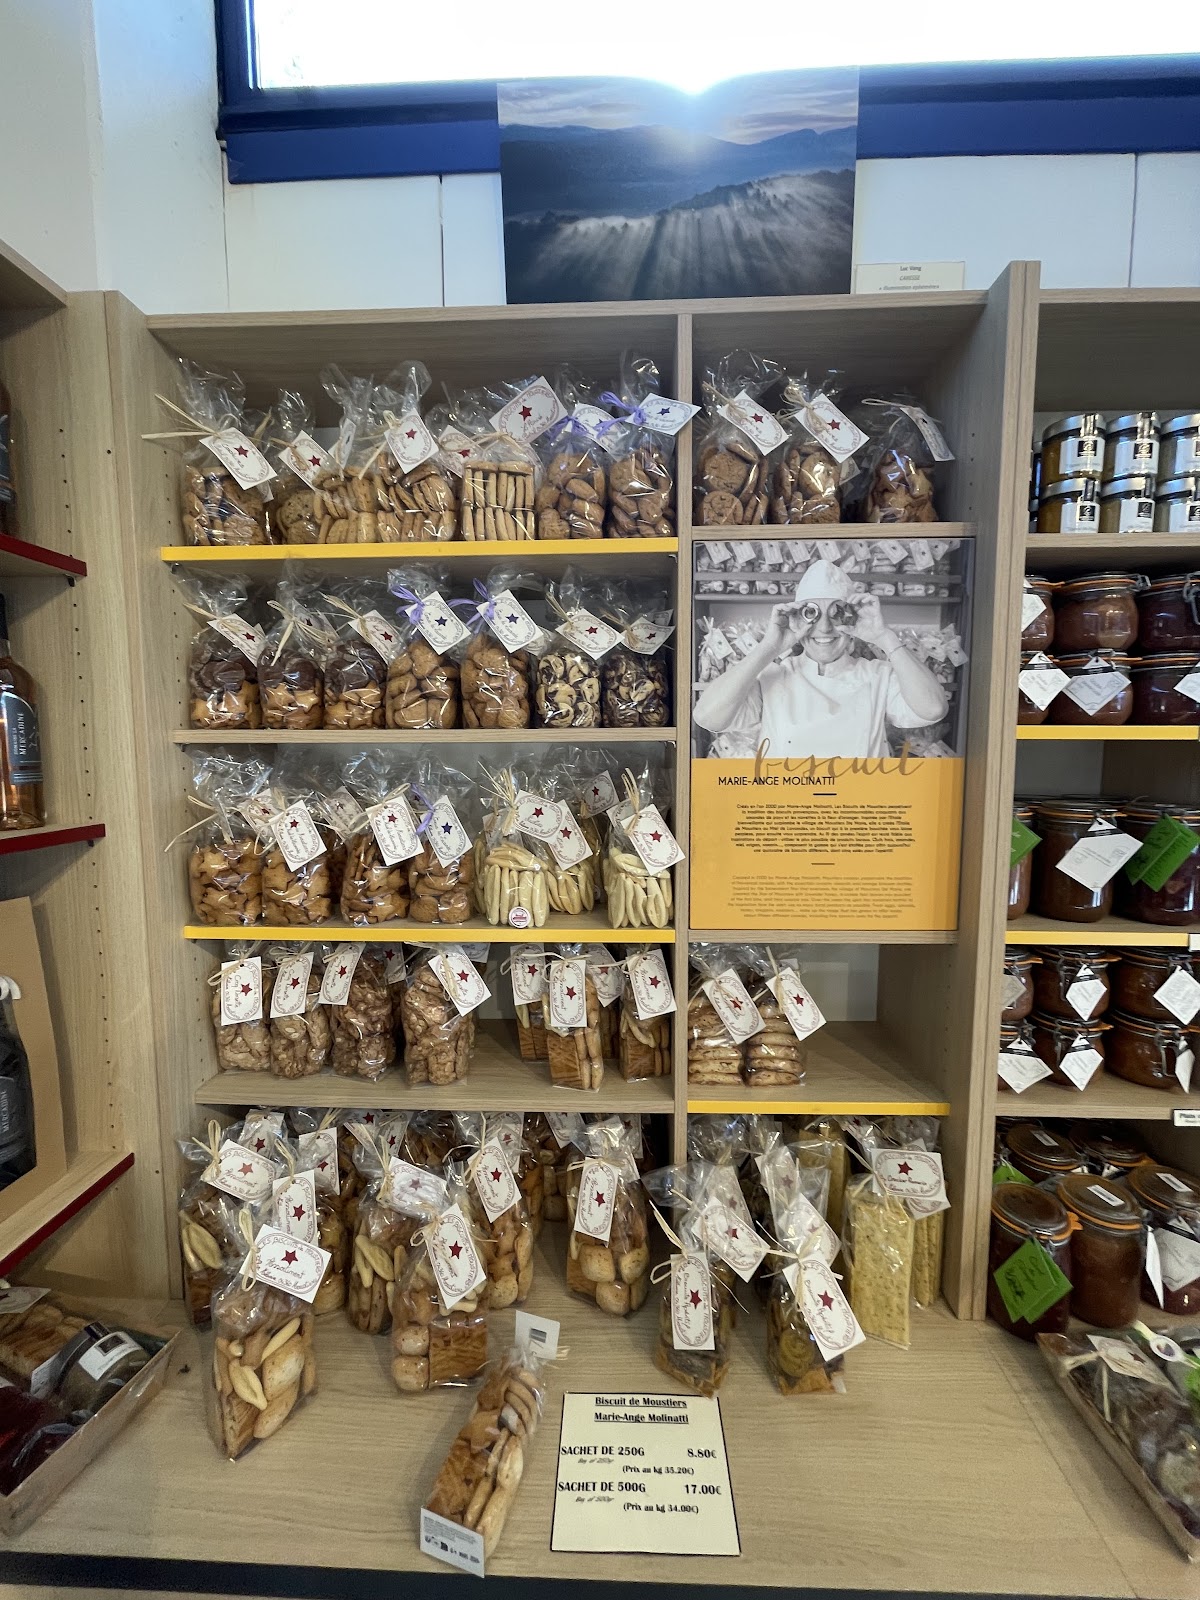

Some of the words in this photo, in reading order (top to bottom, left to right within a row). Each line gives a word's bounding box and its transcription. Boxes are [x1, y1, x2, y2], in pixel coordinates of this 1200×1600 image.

[718, 776, 779, 786] MARIE-ANGE
[783, 776, 835, 786] MOLINATTI
[272, 1236, 298, 1249] BISCUITS
[265, 1256, 305, 1279] Assortiment
[595, 1396, 626, 1407] Biscuit
[629, 1396, 640, 1406] de
[643, 1397, 687, 1408] Moustiers
[594, 1412, 645, 1423] Marie-Ange
[648, 1413, 689, 1423] Molinatti
[561, 1446, 598, 1456] SACHET
[602, 1446, 614, 1456] DE
[618, 1447, 645, 1456] 250G
[687, 1449, 717, 1459] 8.80€
[622, 1465, 640, 1474] (Prix
[653, 1466, 663, 1475] kg
[558, 1482, 597, 1492] SACHET
[600, 1482, 614, 1492] DE
[617, 1482, 646, 1493] 500G
[685, 1484, 722, 1495] 17.00€
[623, 1503, 642, 1512] (Prix
[656, 1504, 666, 1513] kg
